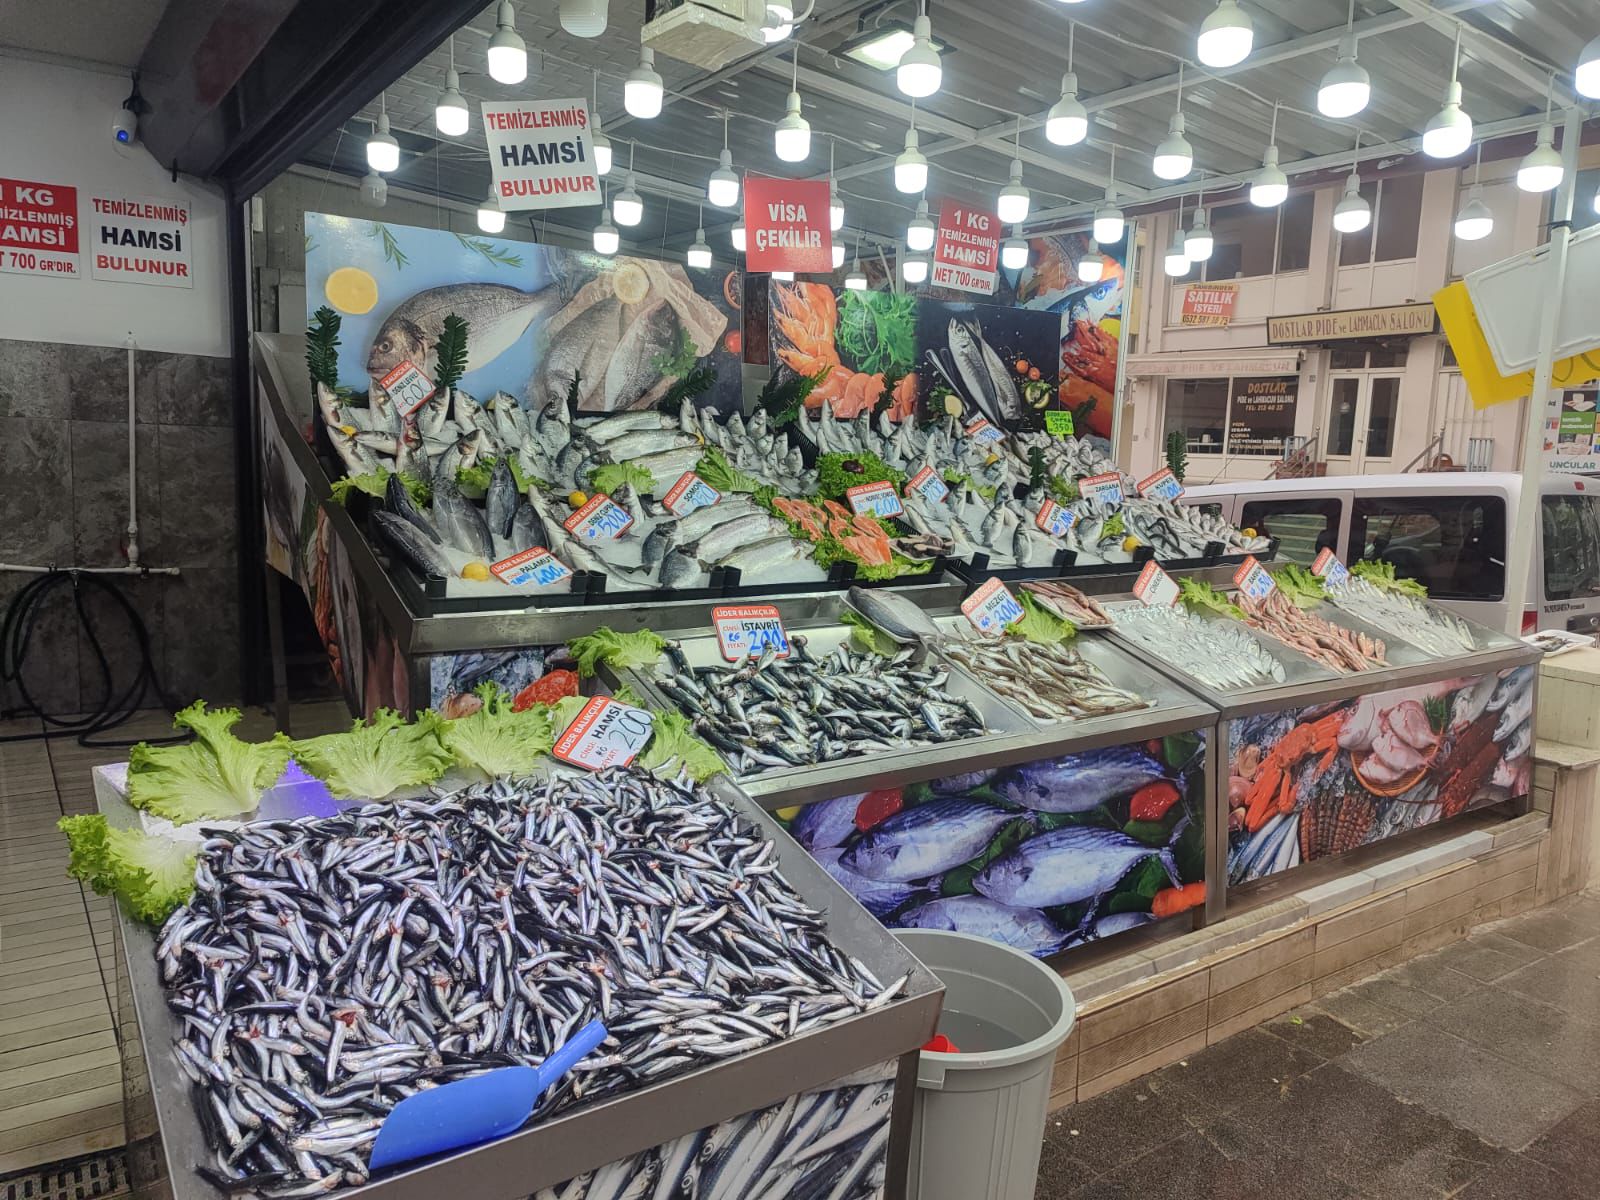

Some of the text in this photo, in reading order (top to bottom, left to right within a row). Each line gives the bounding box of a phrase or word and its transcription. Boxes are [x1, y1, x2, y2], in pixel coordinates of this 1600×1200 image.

[486, 105, 587, 130] TEMİZLENMİŞ
[500, 135, 585, 167] HAMSİ
[15, 186, 54, 206] KG
[500, 175, 596, 197] BULUNUR
[92, 198, 188, 226] TEMİZLENMİŞ
[767, 199, 808, 222] VİSA
[953, 209, 990, 231] 1 KG
[0, 225, 65, 246] AMSİ
[101, 226, 182, 252] HAMSİ
[755, 225, 822, 252] ÇEKİLİR
[940, 227, 998, 252] TEMİZLENMİŞ
[10, 252, 36, 270] 700
[97, 254, 188, 277] BULUNUR
[943, 244, 991, 266] HAMSİ
[934, 267, 954, 283] NET
[955, 270, 972, 287] 700
[1187, 291, 1234, 304] SATILIK
[1272, 319, 1313, 339] DOSTLAR
[1338, 325, 1347, 334] ve
[1349, 313, 1386, 333] LAHMACUN
[1390, 309, 1431, 331] SALONU
[402, 379, 433, 406] 600
[1247, 382, 1287, 393] DOSTLAR
[684, 481, 703, 502] SOMON
[519, 555, 554, 574] PALAMUT
[716, 607, 776, 617] LİDER BALIKÇILIK
[740, 619, 780, 632] İSTAVRİT
[558, 698, 605, 754] LİDER BALIKÇILIK
[591, 704, 623, 739] HAMSİ
[608, 709, 653, 750] 200
